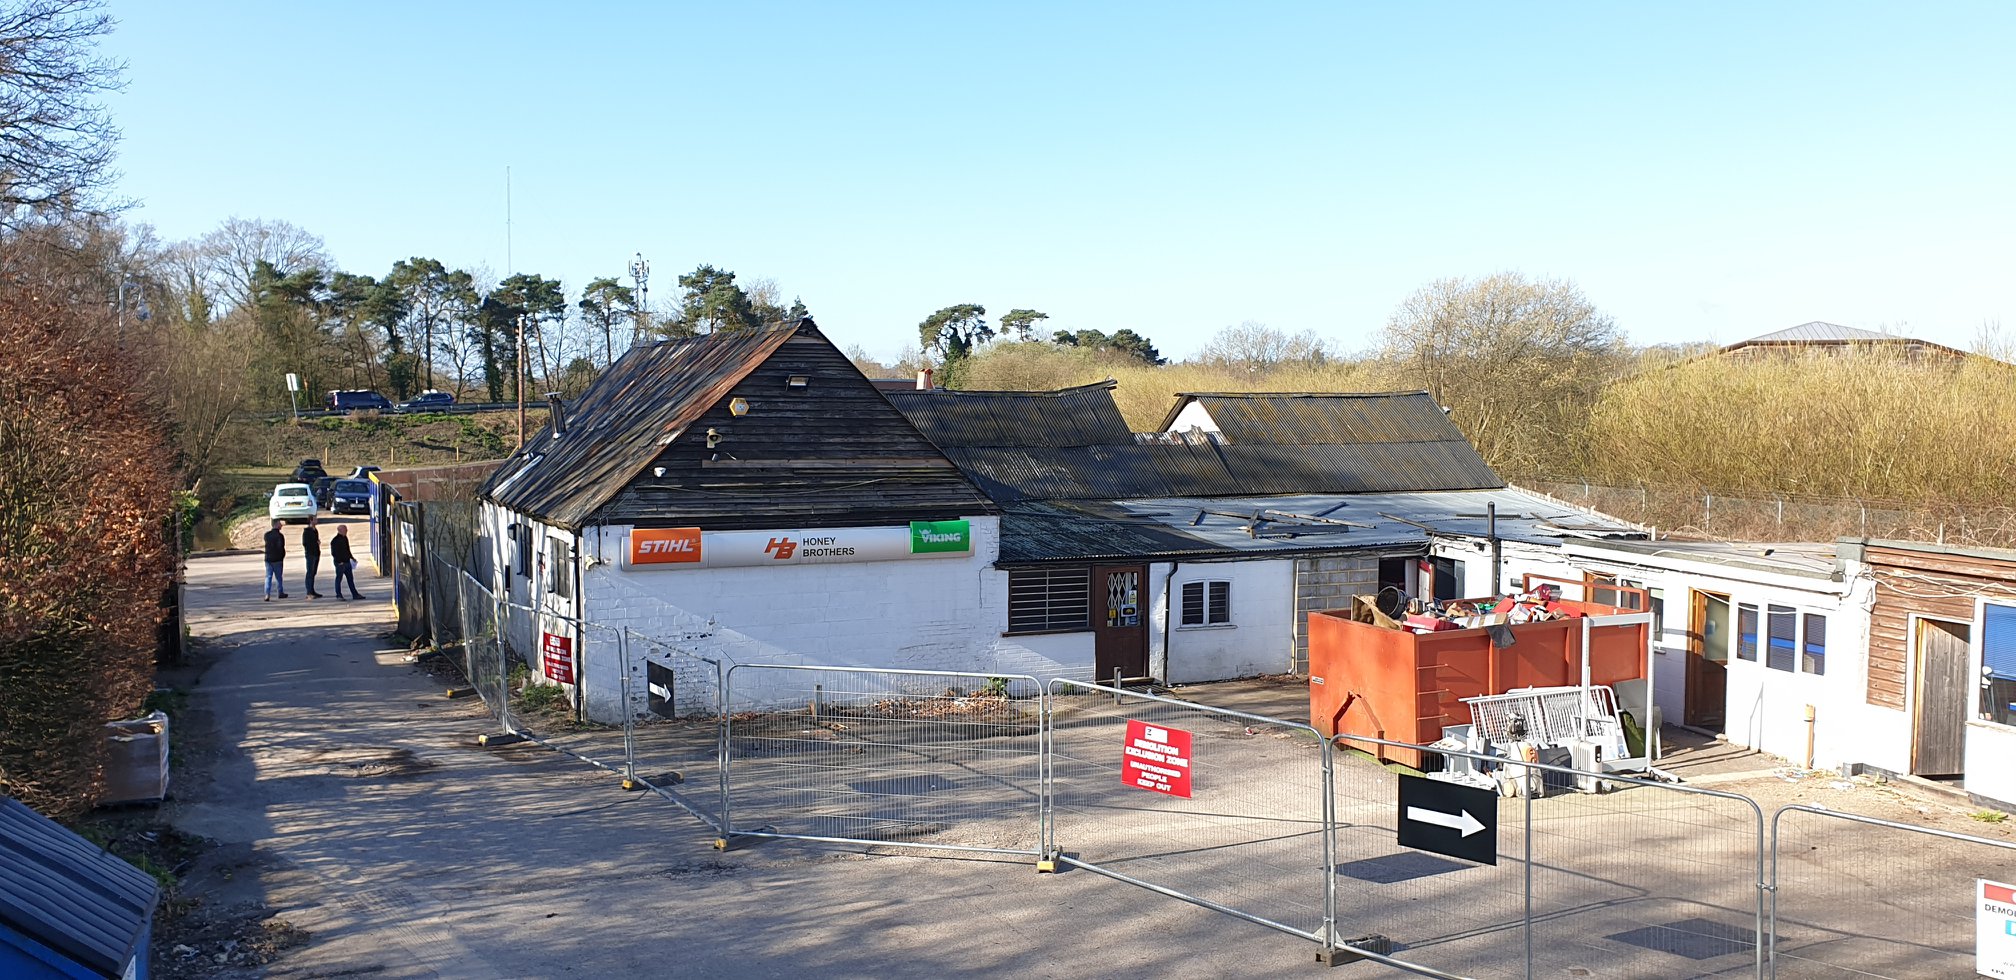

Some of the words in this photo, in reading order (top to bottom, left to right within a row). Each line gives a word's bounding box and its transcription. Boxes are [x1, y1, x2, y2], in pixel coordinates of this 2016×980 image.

[802, 536, 837, 547] HONEY
[921, 531, 962, 544] VIKING
[638, 538, 694, 554] STIHL
[763, 537, 798, 560] HB
[802, 547, 856, 558] BROTHERS
[1155, 782, 1172, 792] OUT
